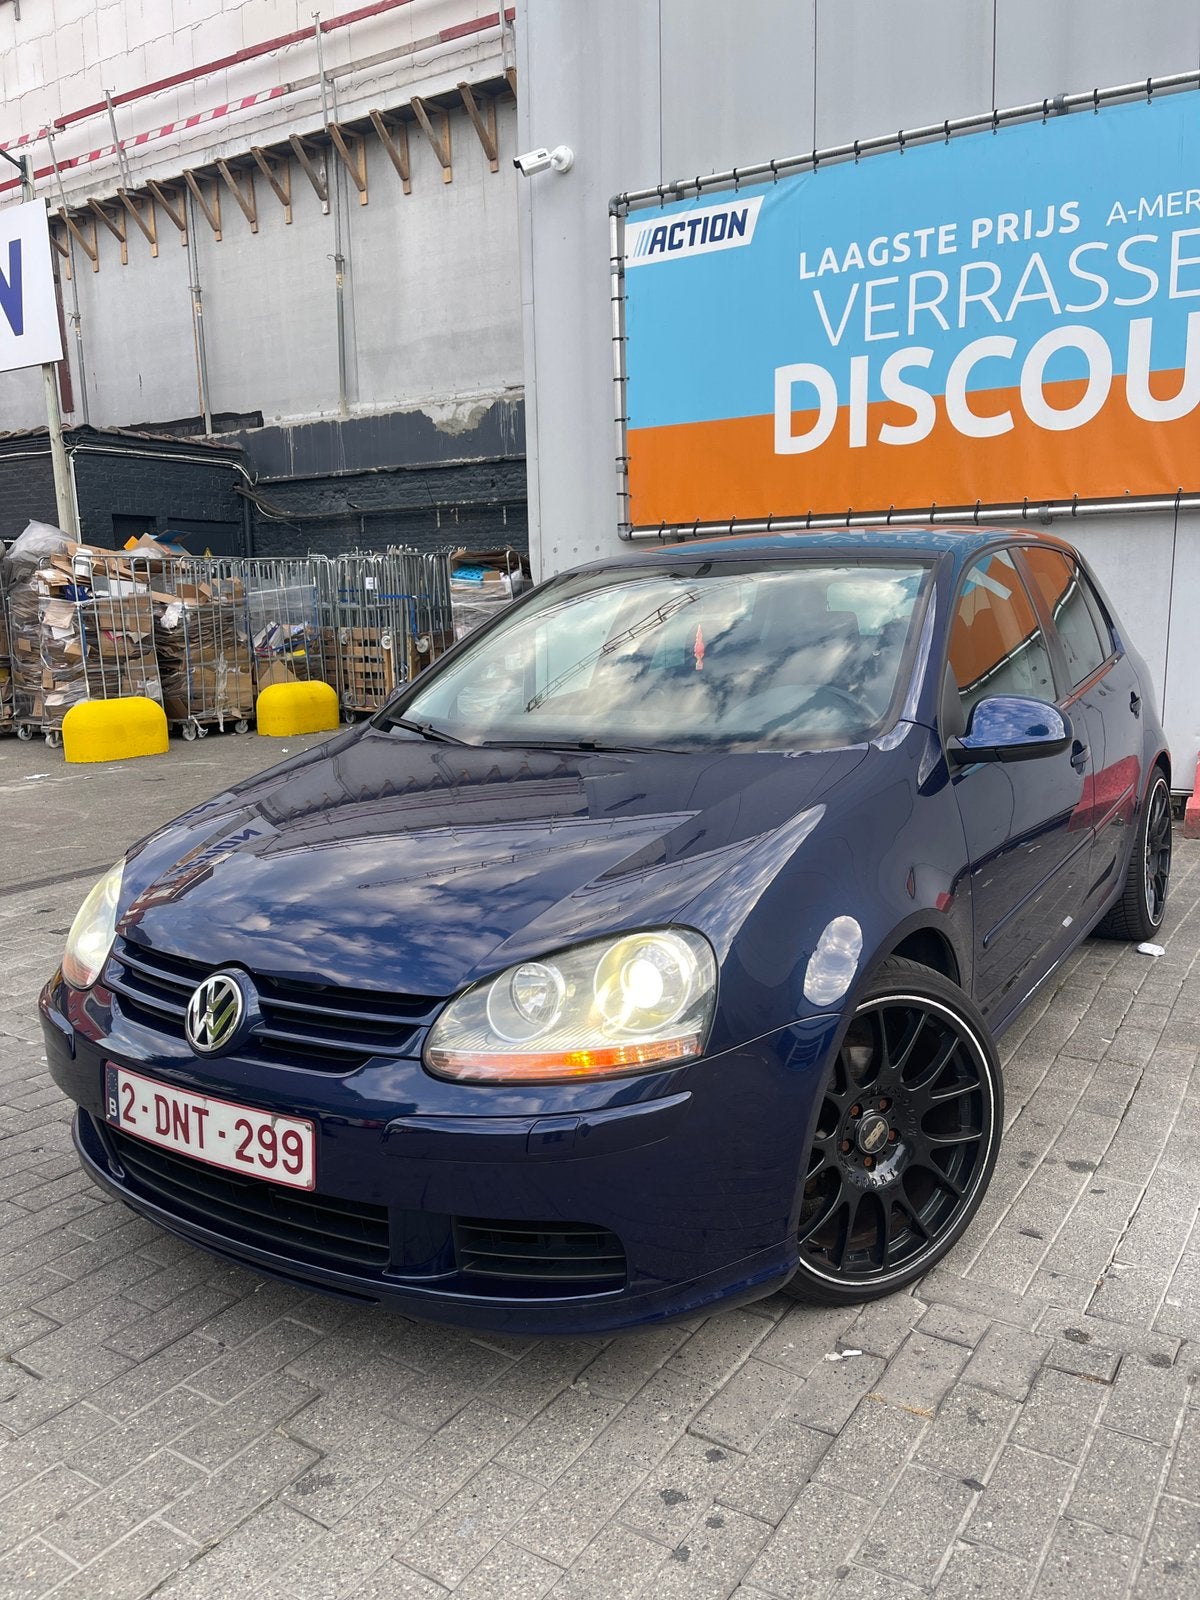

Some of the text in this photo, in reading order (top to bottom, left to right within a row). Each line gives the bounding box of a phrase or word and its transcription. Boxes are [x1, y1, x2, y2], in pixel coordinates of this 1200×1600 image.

[648, 208, 749, 255] ACTION
[799, 189, 1200, 281] LAAGSTE PRIJS A-MER
[812, 228, 1200, 347] VERRASSE
[774, 311, 1200, 456] DISCOU
[108, 1097, 118, 1117] B
